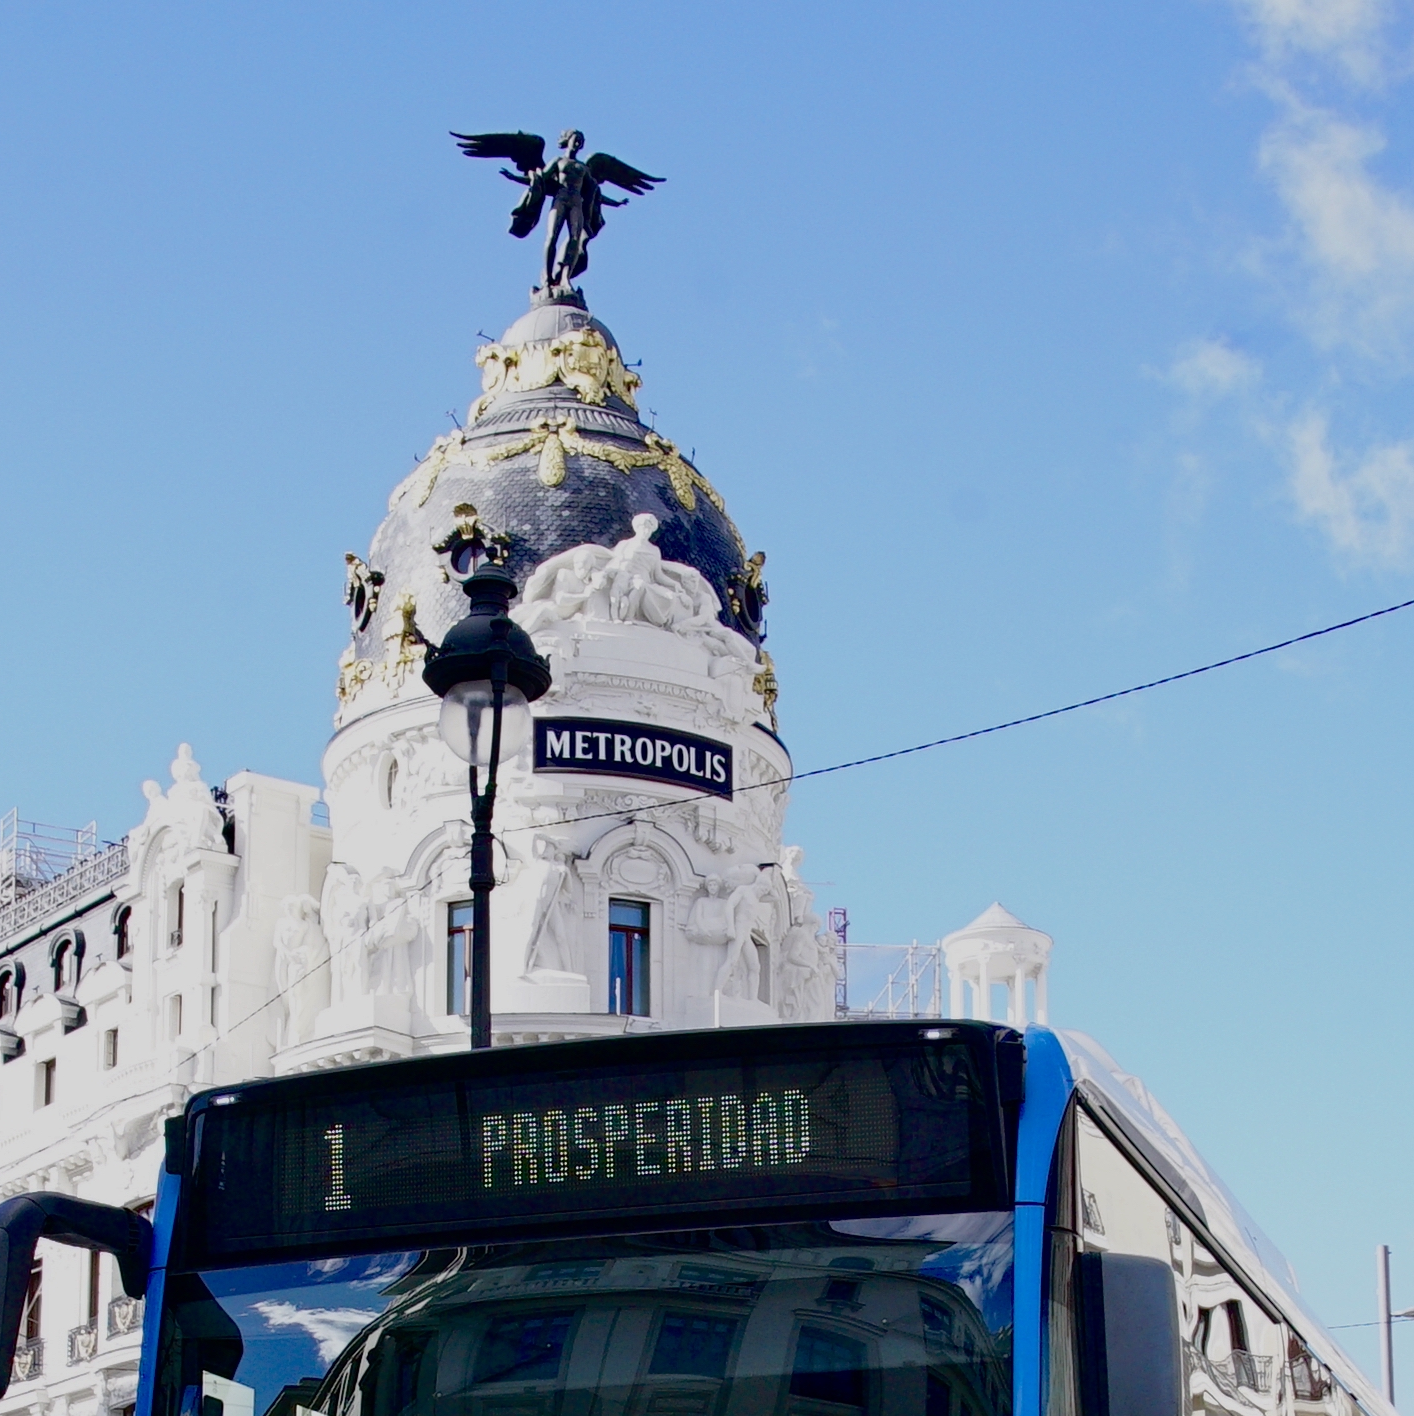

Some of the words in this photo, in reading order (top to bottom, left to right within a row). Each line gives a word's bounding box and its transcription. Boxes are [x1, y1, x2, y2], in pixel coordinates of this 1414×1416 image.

[546, 730, 727, 783] METROPOLIS
[324, 1124, 352, 1211] 1
[482, 1089, 811, 1188] PROSPERIDAD
